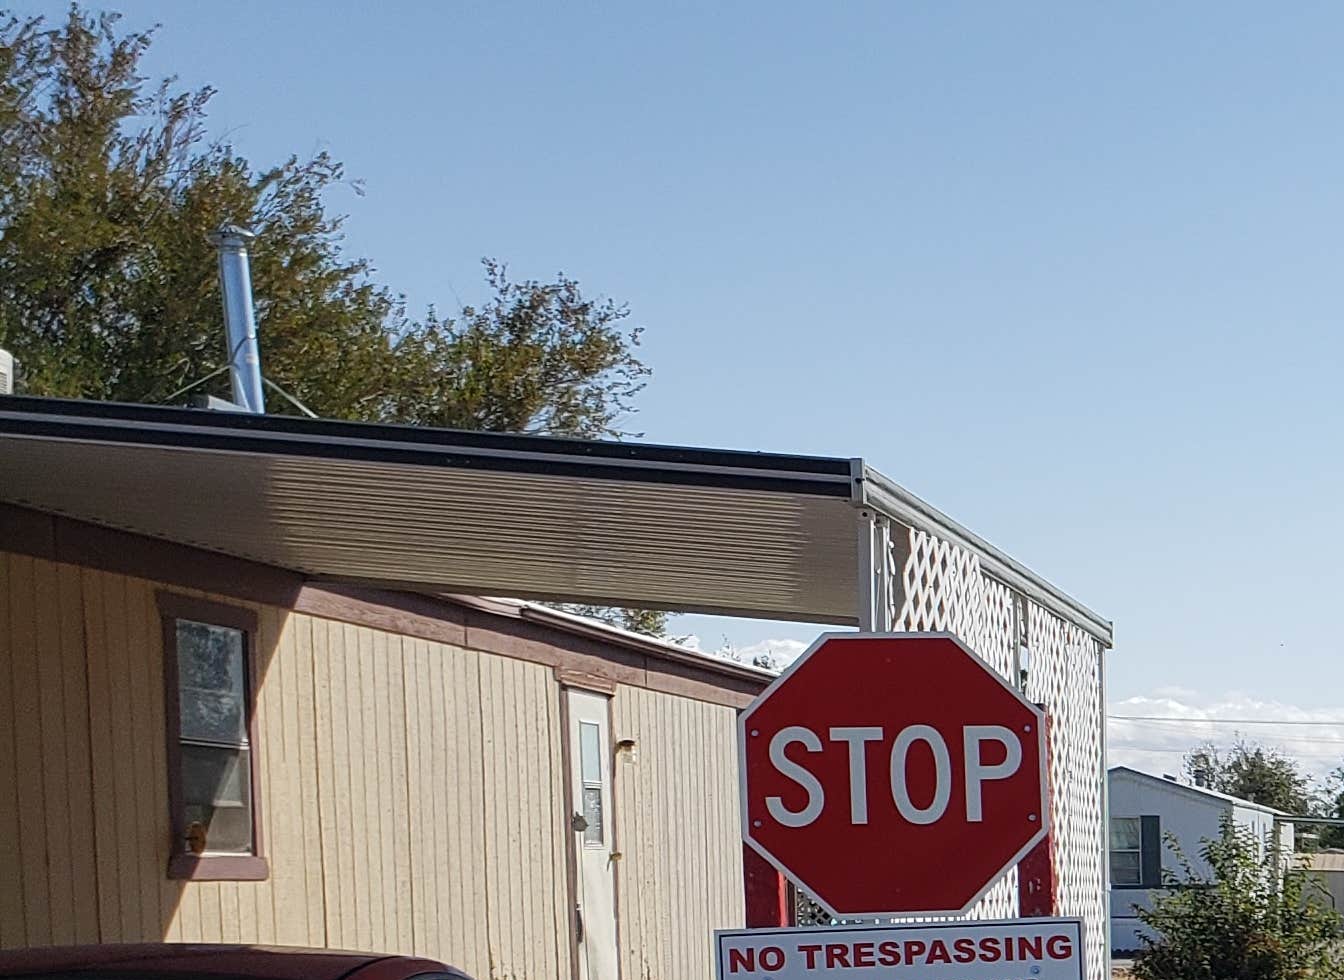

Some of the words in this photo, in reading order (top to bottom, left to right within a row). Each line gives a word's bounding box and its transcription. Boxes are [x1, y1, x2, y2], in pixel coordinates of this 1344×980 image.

[765, 725, 1022, 827] STOP
[729, 947, 785, 973] NO
[798, 936, 1071, 969] TRESPASSING
